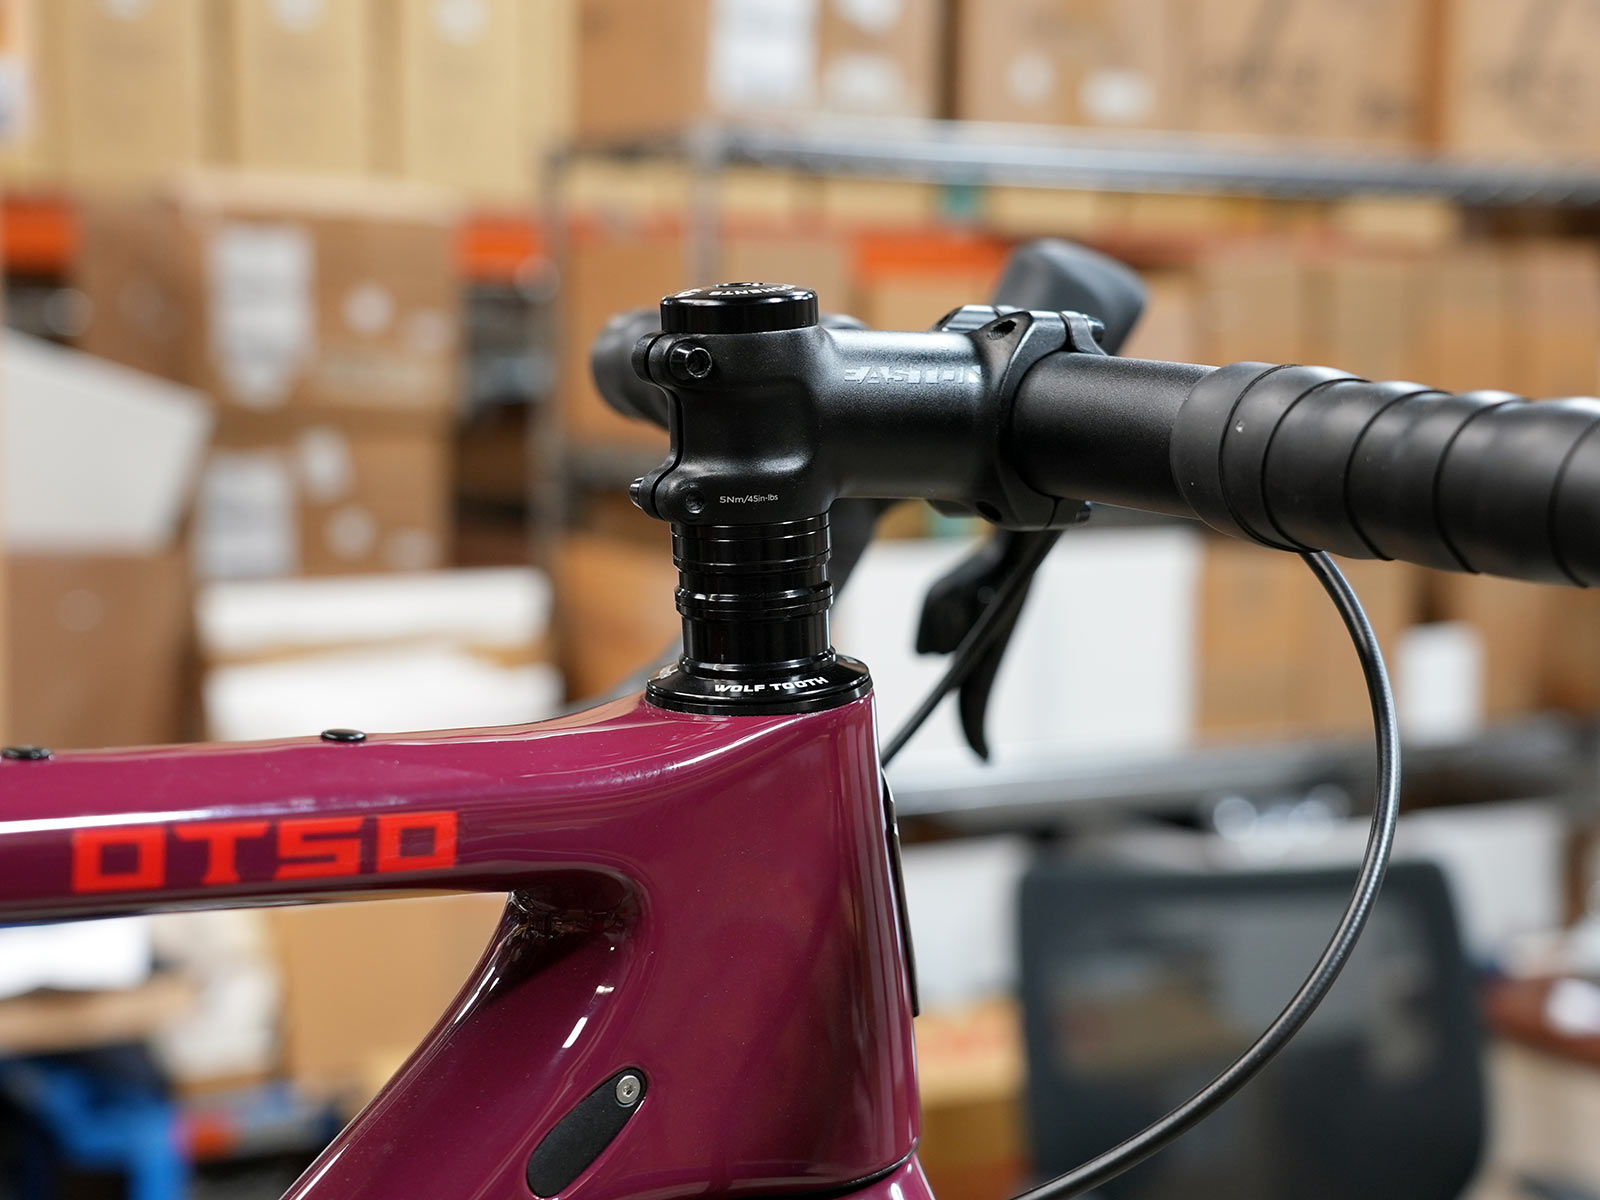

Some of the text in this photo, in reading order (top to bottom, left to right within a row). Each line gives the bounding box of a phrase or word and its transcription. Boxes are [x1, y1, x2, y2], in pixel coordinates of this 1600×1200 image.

[841, 365, 985, 385] EASTON
[714, 676, 829, 693] WOLF TOOTH
[71, 810, 458, 893] OTSO
